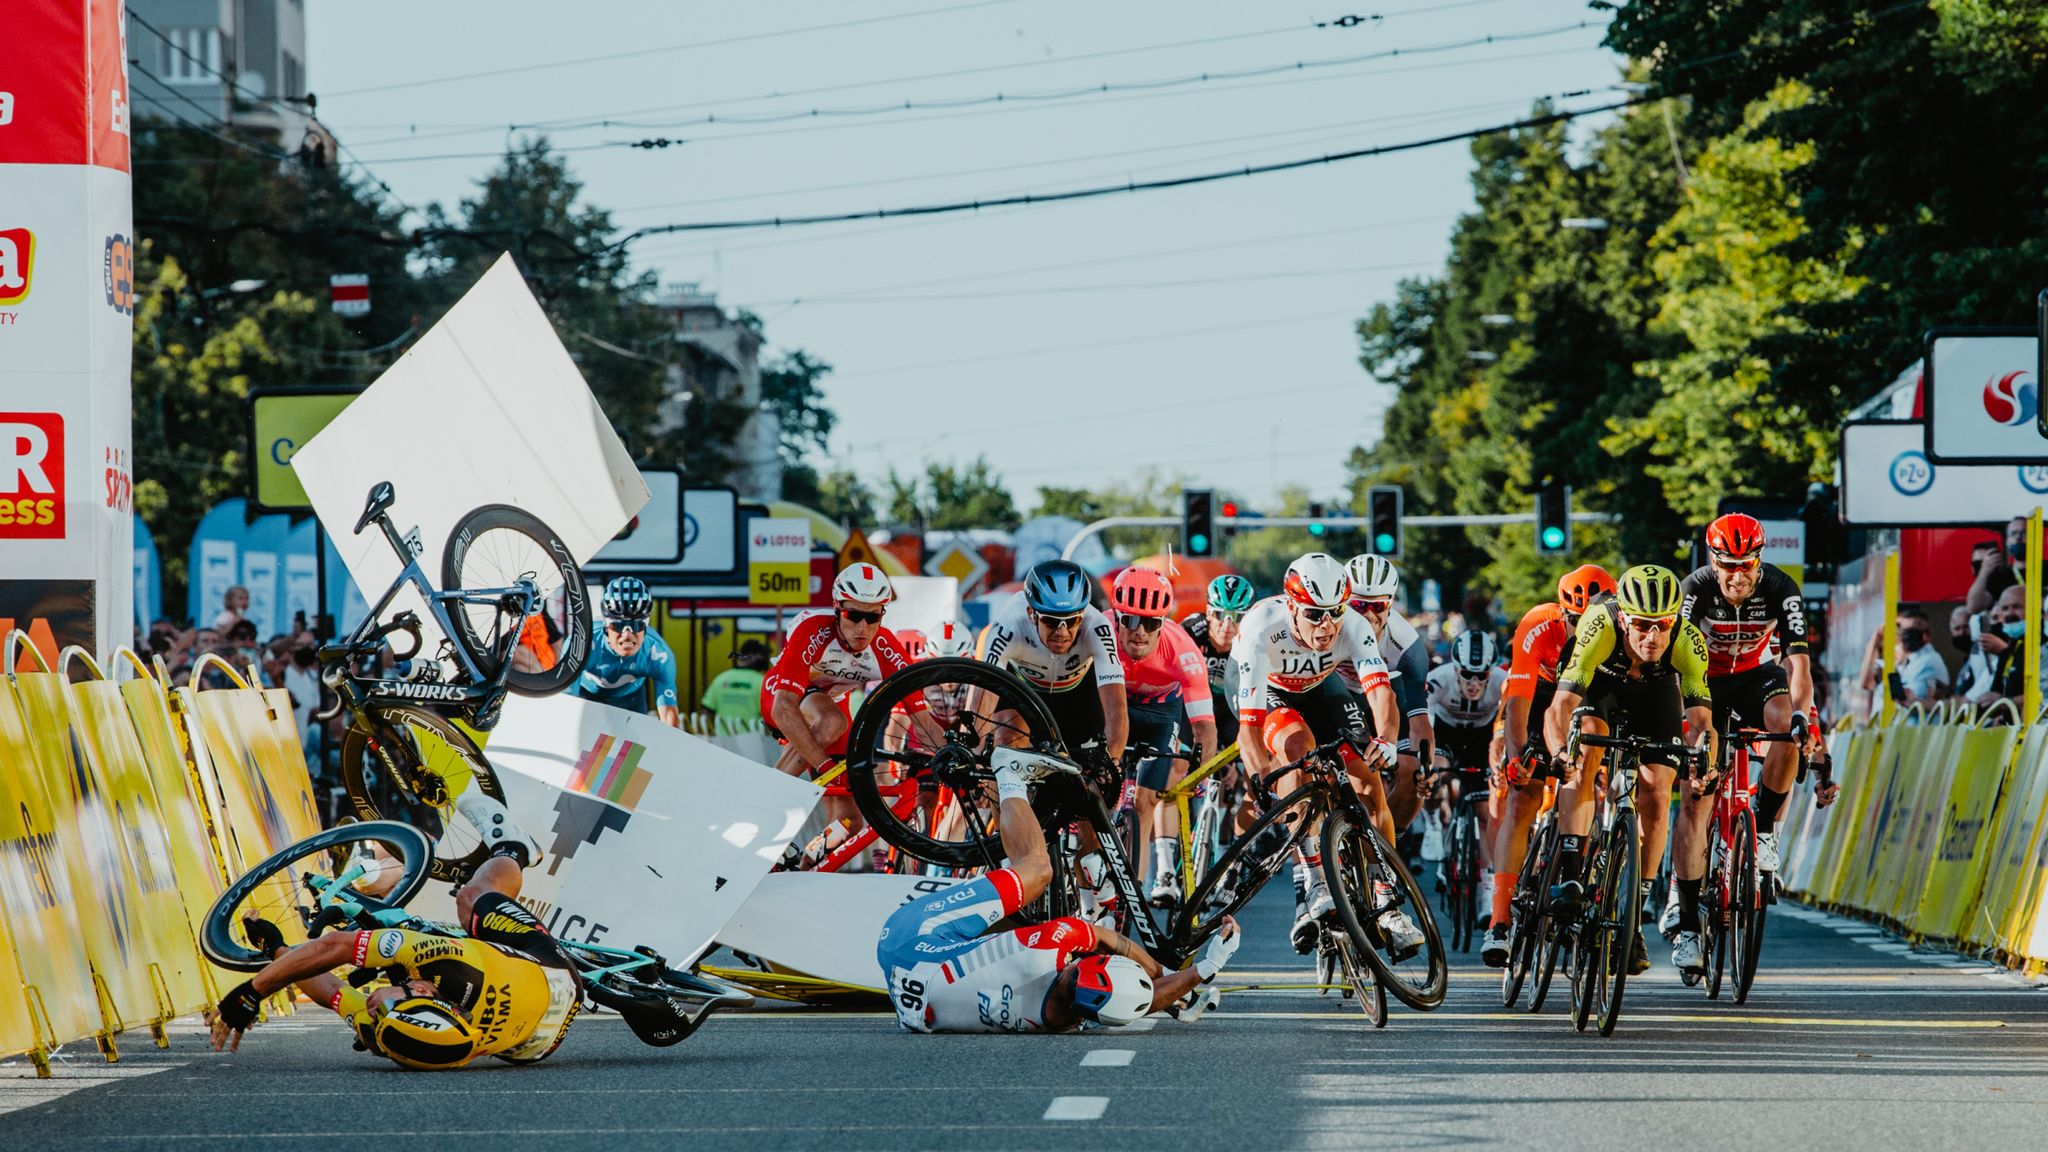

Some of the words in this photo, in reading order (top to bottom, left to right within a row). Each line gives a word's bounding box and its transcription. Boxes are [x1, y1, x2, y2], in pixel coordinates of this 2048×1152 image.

[1899, 463, 1926, 483] PZU
[770, 535, 805, 547] LOTOS
[759, 571, 801, 593] 50m
[1270, 630, 1288, 644] UAE
[1522, 620, 1550, 654] GIANT
[1577, 613, 1606, 648] letsgo
[1683, 623, 1708, 662] letsgo
[802, 626, 832, 666] Cofidis
[987, 625, 1014, 666] BMC
[1094, 624, 1120, 666] BMC
[1178, 651, 1204, 676] EF
[1281, 652, 1334, 676] UAE
[1357, 657, 1383, 668] FAB
[376, 681, 467, 701] S-WORKS
[1343, 702, 1366, 729] UAE
[1098, 831, 1159, 950] LAPIERRE
[354, 929, 373, 968] HEMA
[412, 938, 447, 953] VISMA
[414, 946, 464, 964] JUMBO
[900, 977, 925, 1012] 96
[396, 1011, 442, 1031] LAZER
[485, 983, 512, 1046] VISMA
